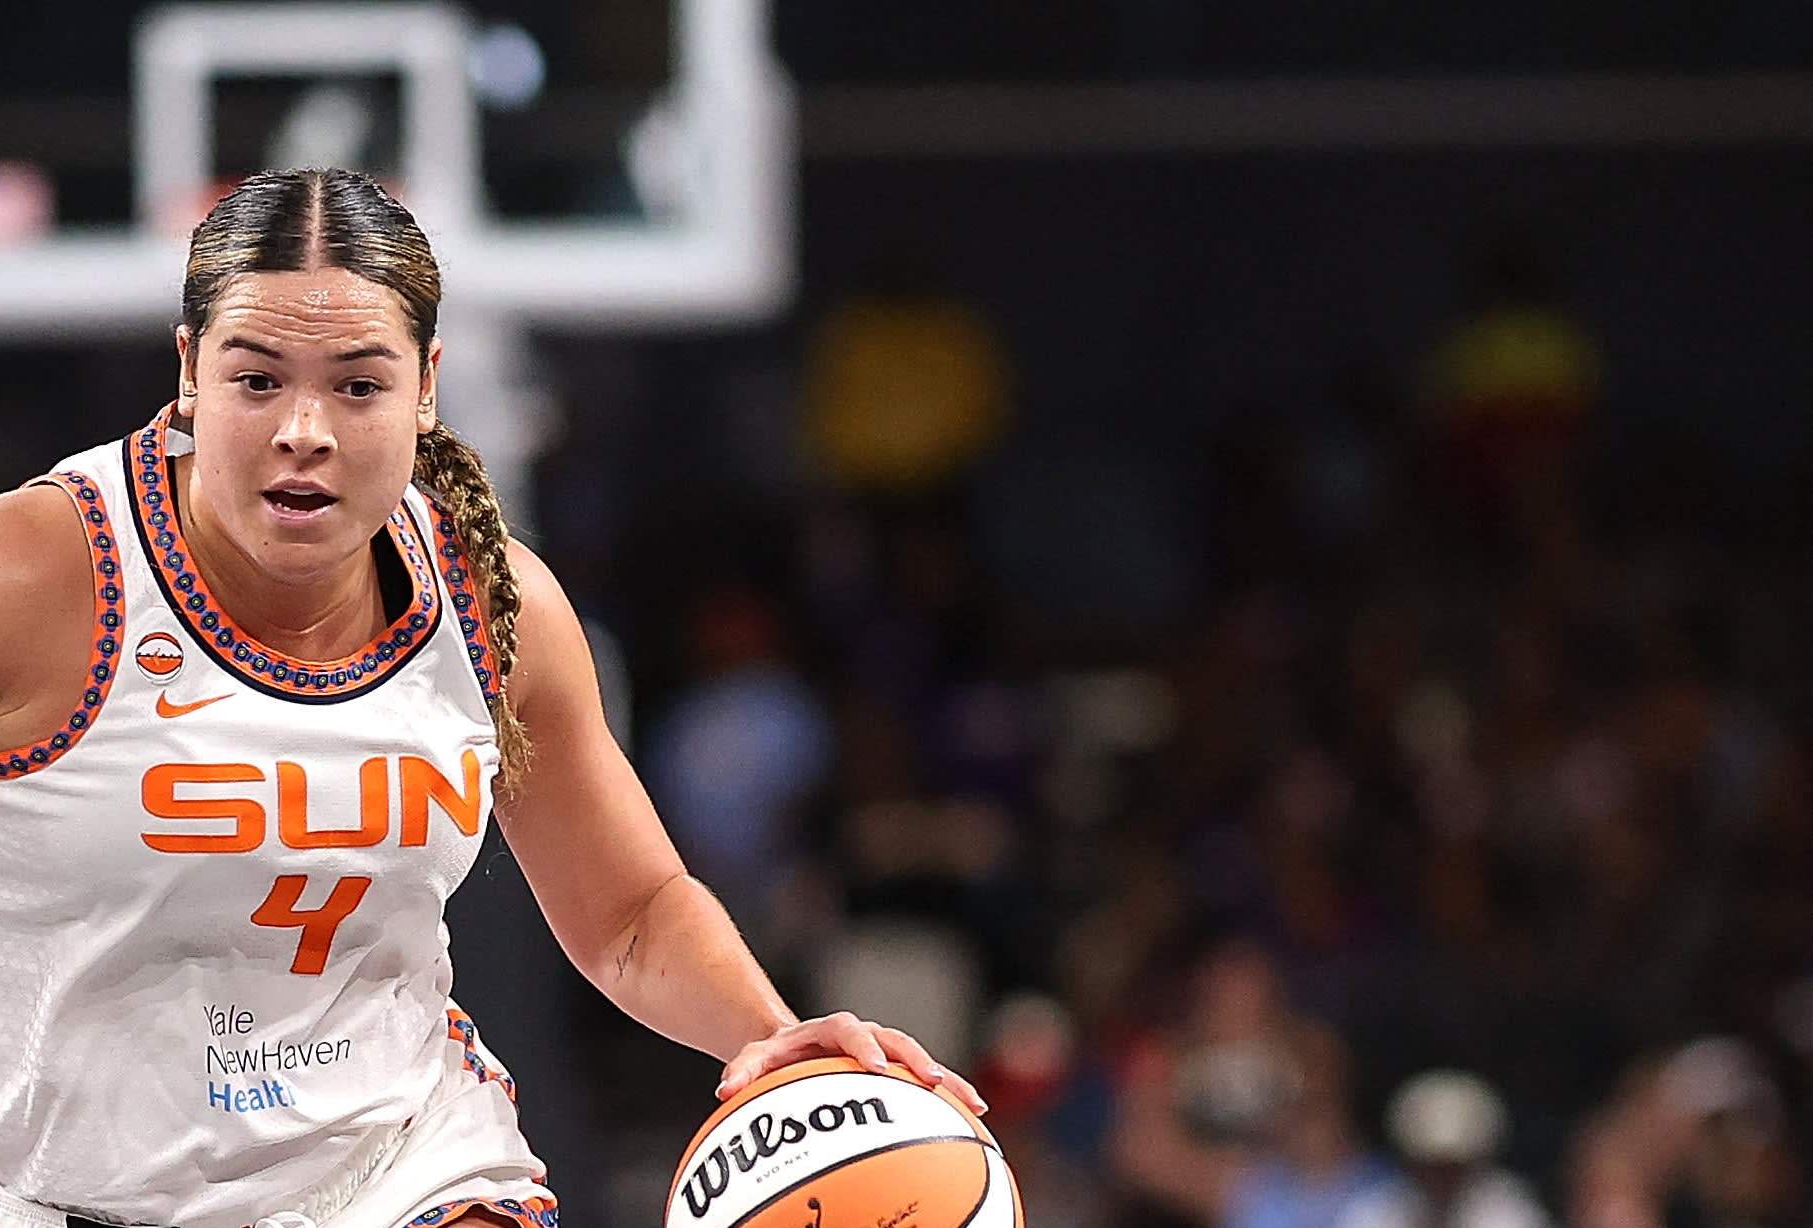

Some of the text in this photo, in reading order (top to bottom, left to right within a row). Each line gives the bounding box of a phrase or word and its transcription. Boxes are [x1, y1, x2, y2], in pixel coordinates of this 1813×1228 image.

[140, 748, 481, 853] SUN
[250, 873, 373, 975] 4
[203, 1003, 254, 1036] Yale
[681, 1097, 894, 1218] Wilson
